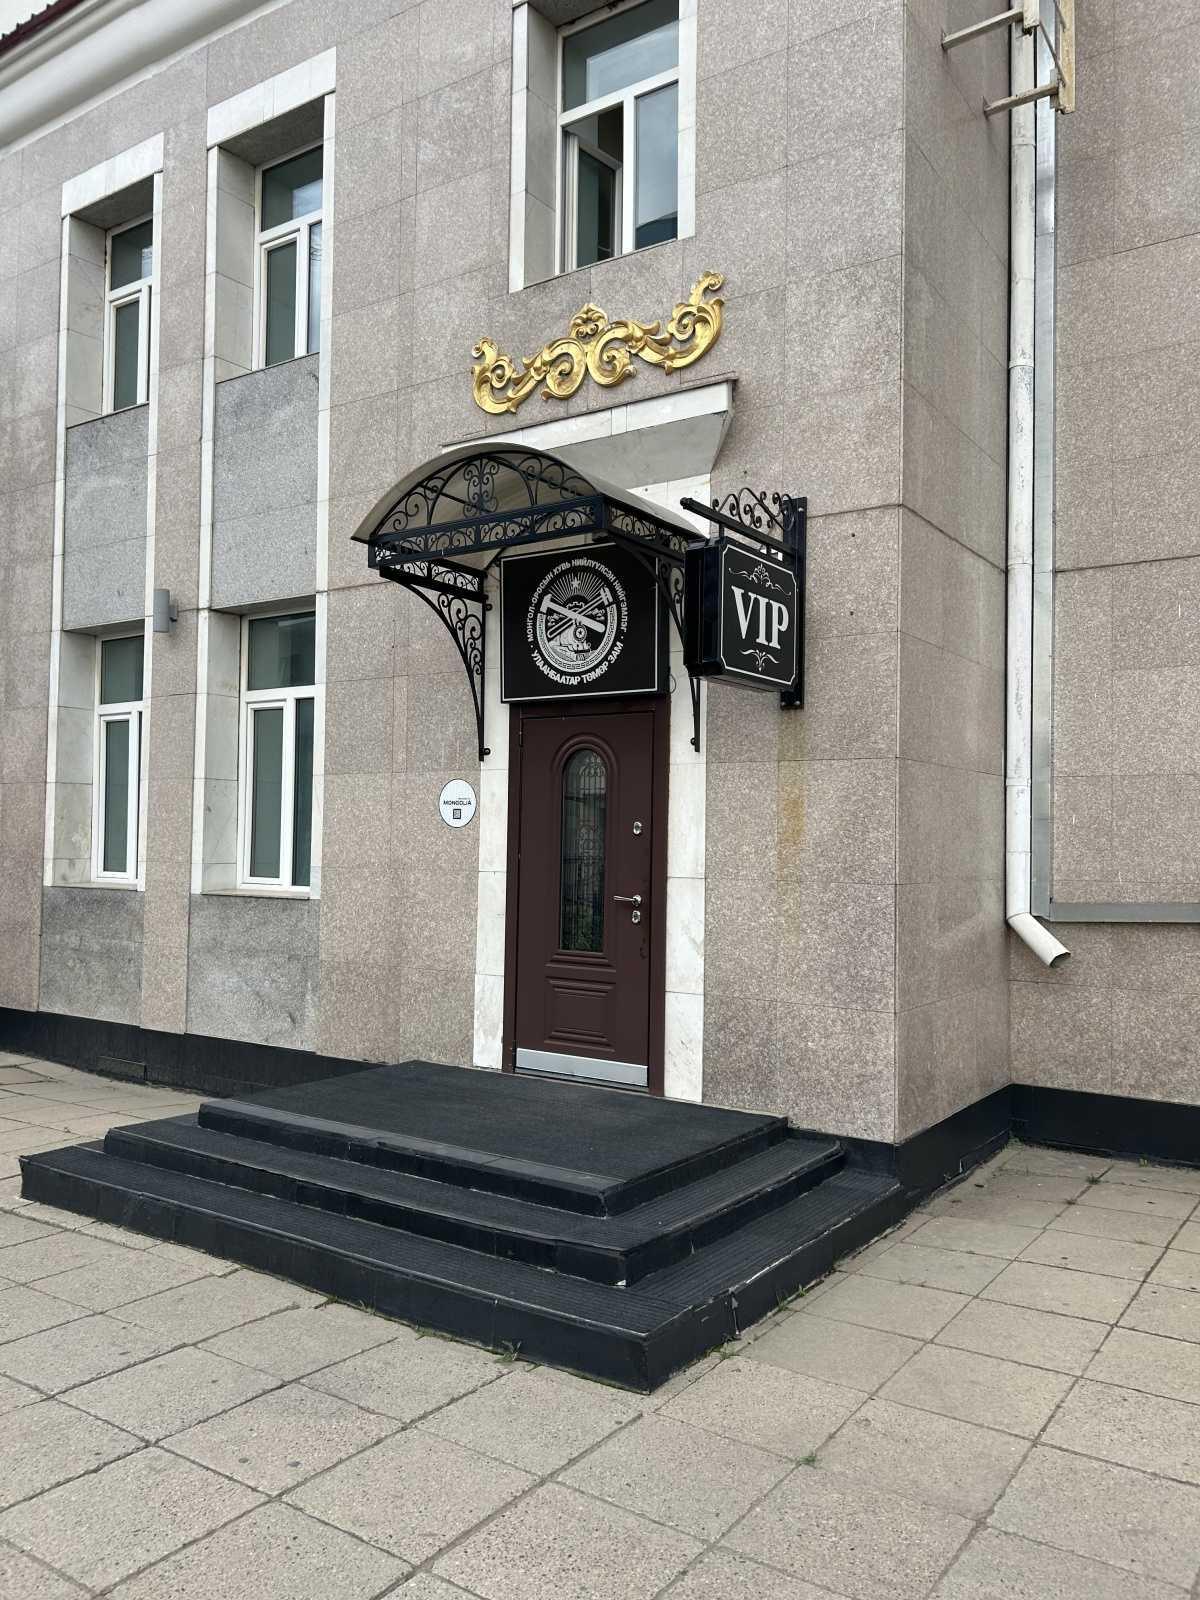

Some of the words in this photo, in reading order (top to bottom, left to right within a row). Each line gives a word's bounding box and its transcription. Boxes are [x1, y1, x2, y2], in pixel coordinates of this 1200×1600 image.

[527, 571, 554, 642] МОНГОЛ-ОРОСЫН
[553, 561, 571, 576] ХУВЬ
[731, 585, 789, 649] VIP
[531, 649, 581, 685] УЛААНБААТАР
[607, 641, 624, 664] ЗАМ
